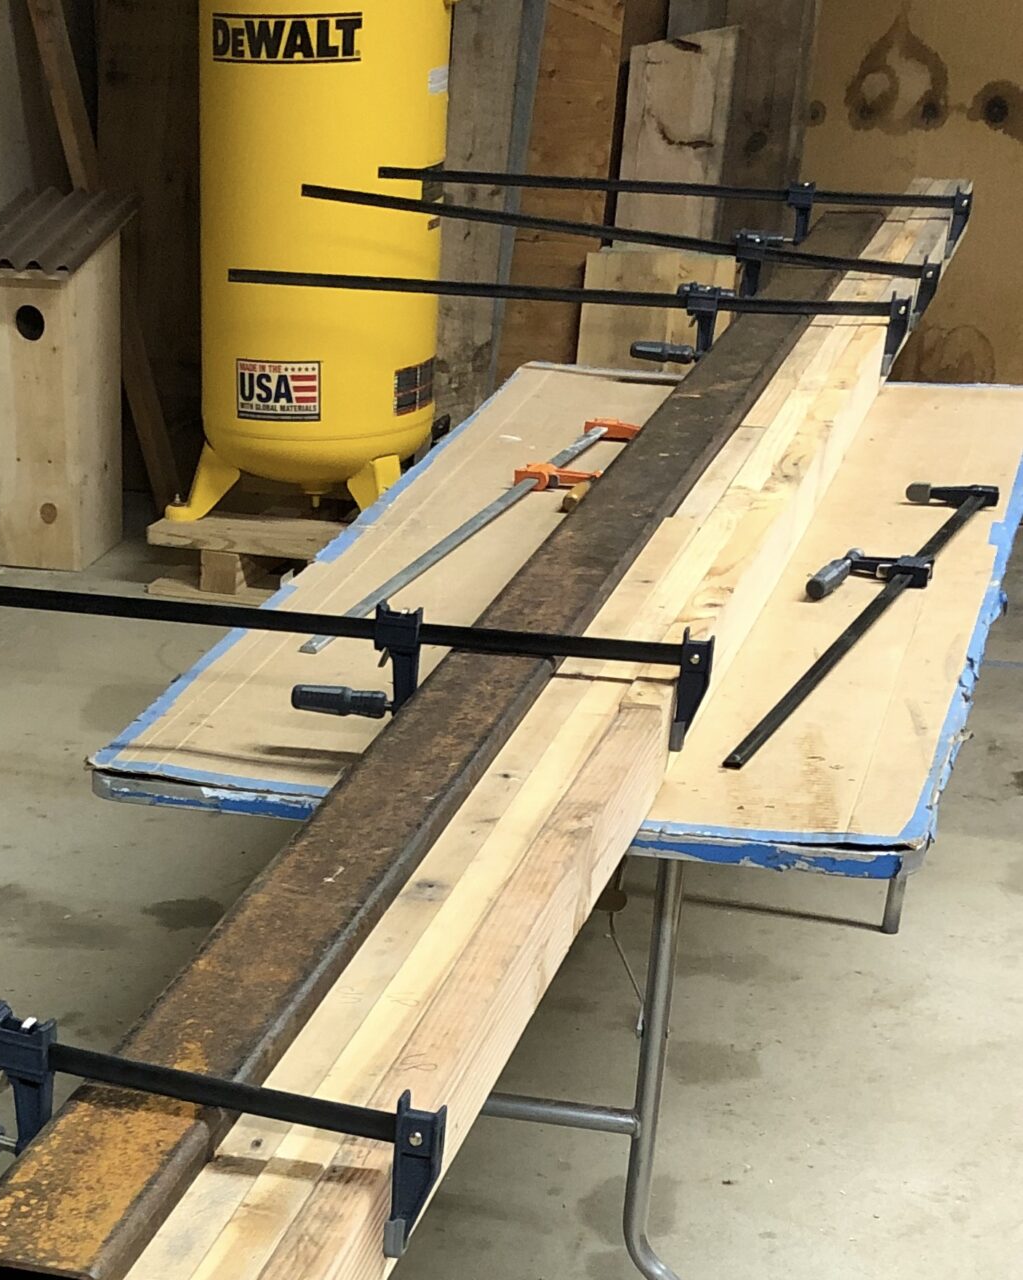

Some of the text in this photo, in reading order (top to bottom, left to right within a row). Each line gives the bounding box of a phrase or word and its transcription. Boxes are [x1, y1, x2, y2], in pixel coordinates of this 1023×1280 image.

[239, 363, 282, 373] MADE IN THE
[239, 372, 294, 404] USA
